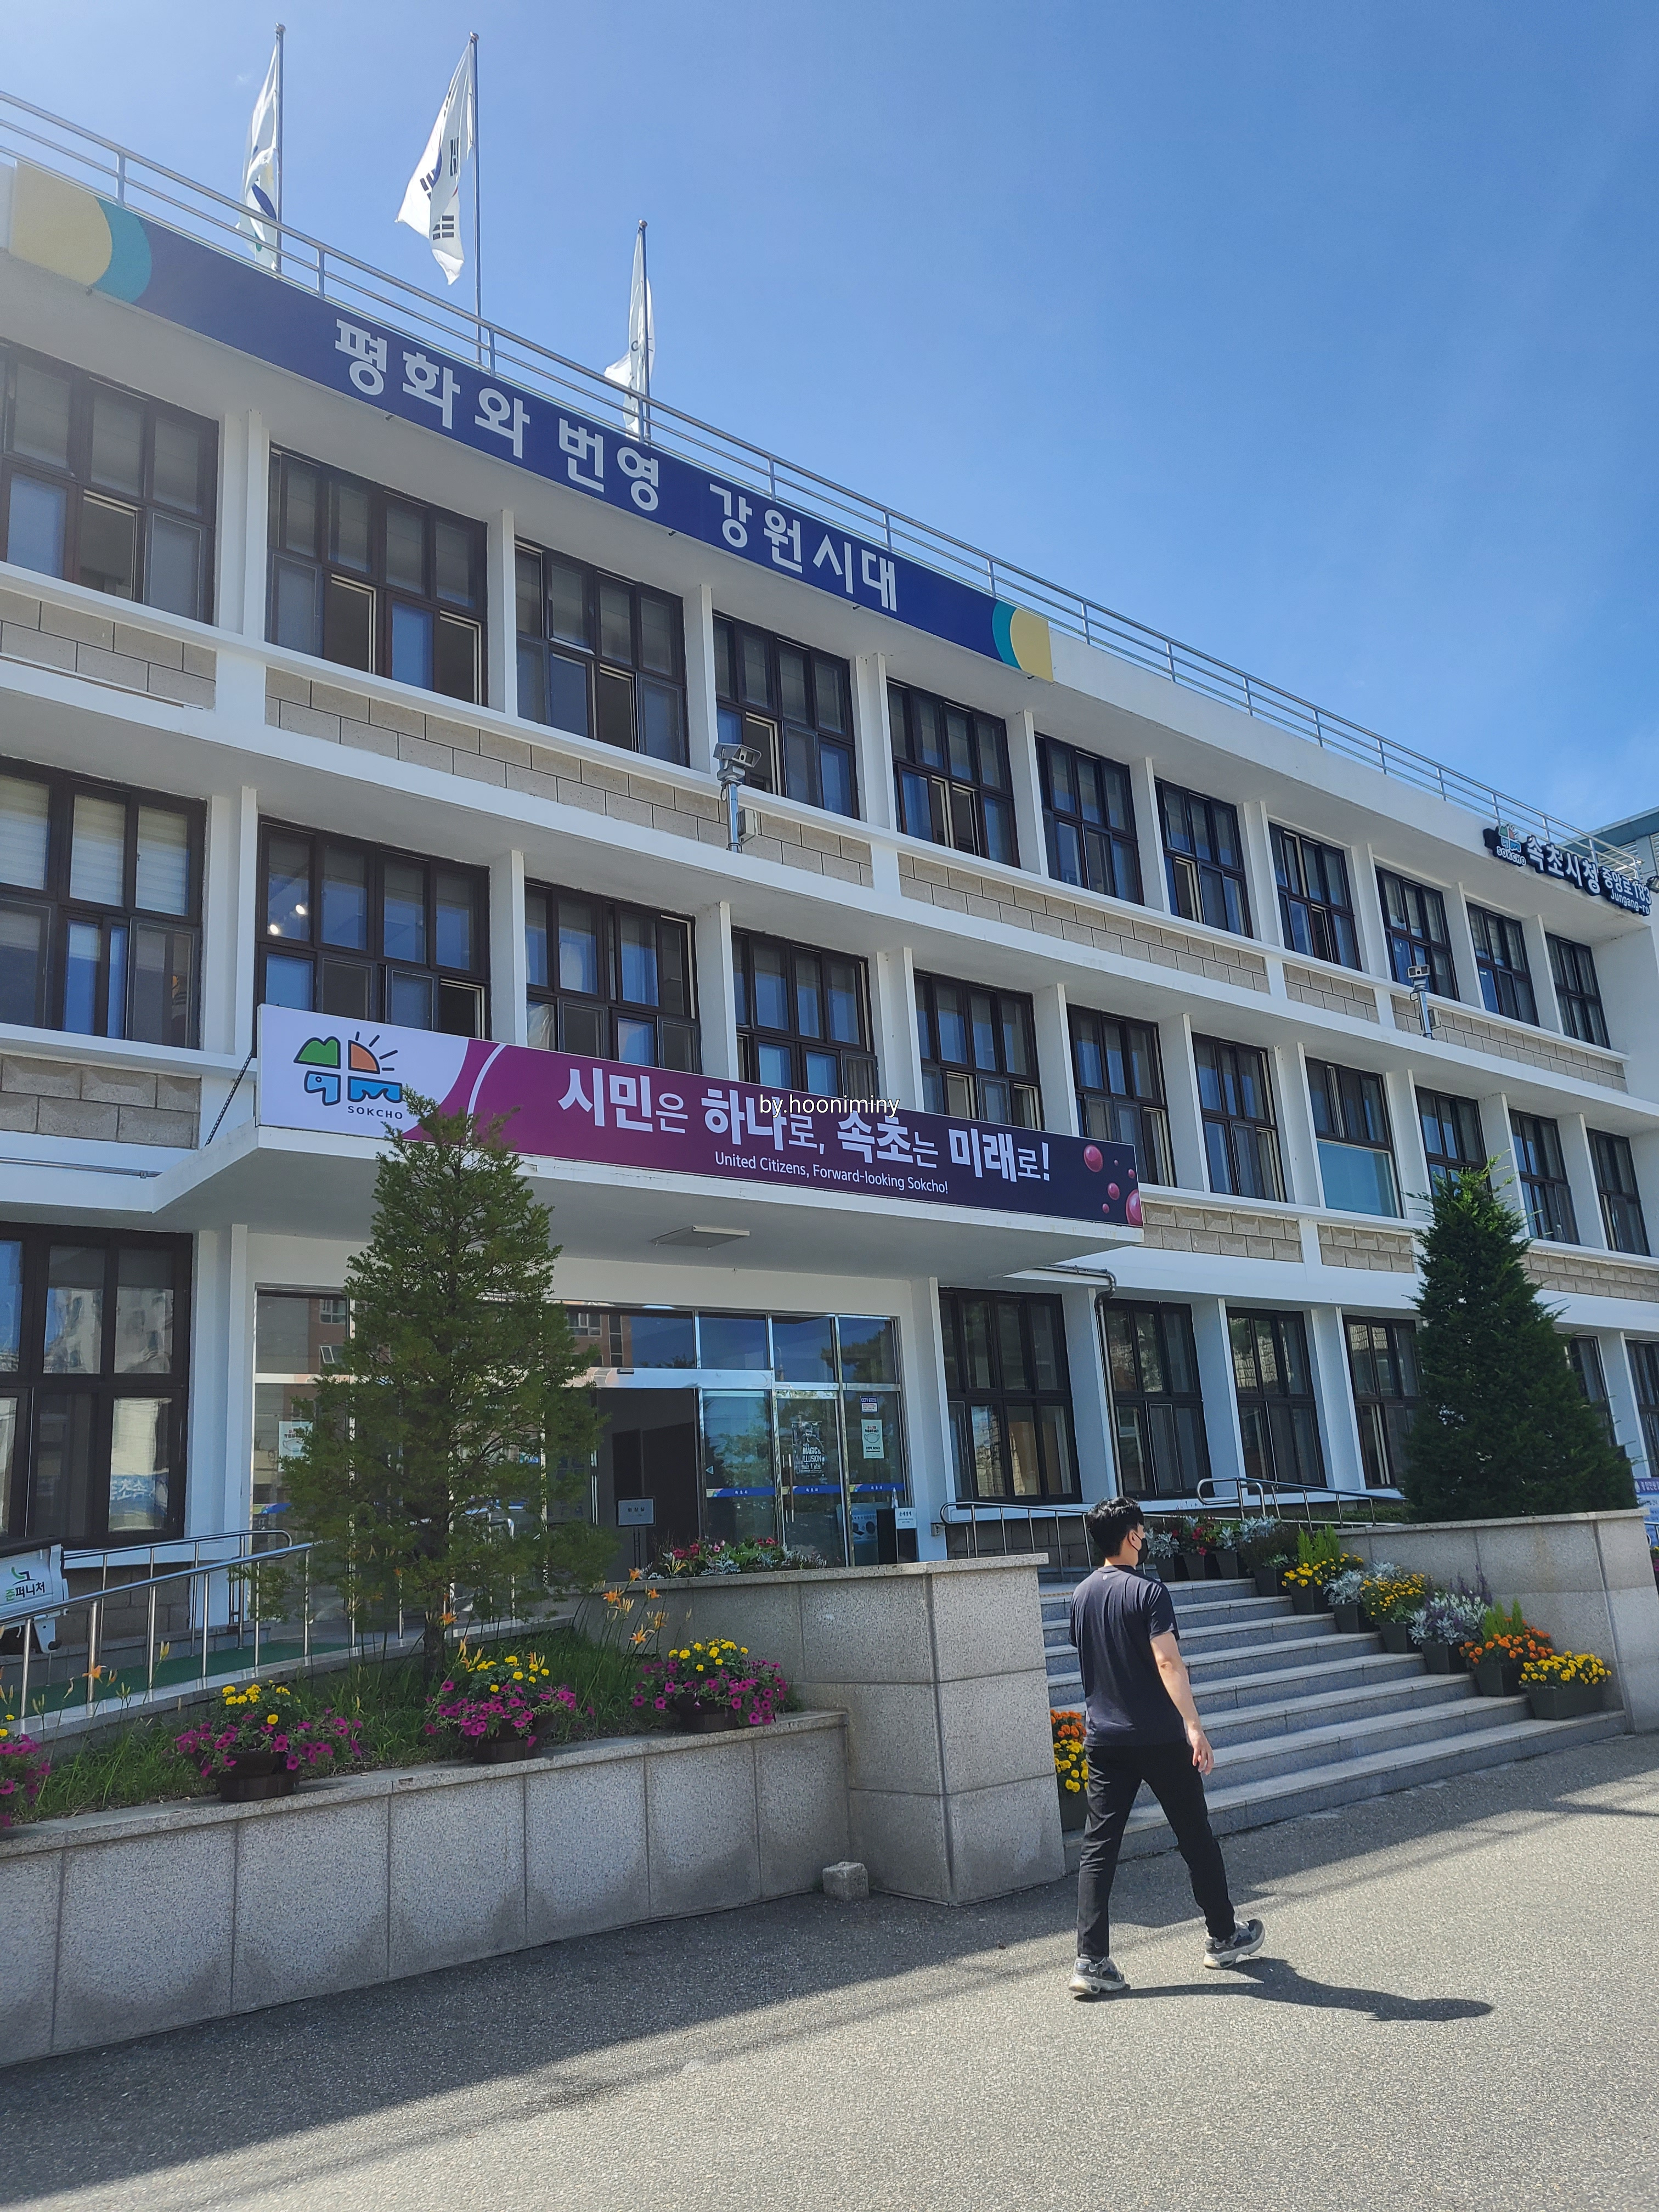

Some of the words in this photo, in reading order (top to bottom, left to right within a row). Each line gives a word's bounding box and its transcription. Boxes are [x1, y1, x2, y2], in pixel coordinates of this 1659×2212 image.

[335, 318, 531, 459] 평화와
[558, 417, 659, 511] 번영
[709, 483, 898, 612] 강원시대
[1497, 846, 1526, 866] SOKCHO
[1527, 836, 1600, 894] 속초시청
[1611, 889, 1650, 915] Jungang-ro
[347, 1105, 403, 1119] SOKCHO
[558, 1067, 688, 1133] 시민은
[701, 1088, 825, 1155] 하나로,
[837, 1110, 939, 1169] 속초는
[949, 1128, 1050, 1182] 미래로!
[715, 1151, 756, 1169] United
[760, 1157, 810, 1178] Citizens,
[812, 1164, 905, 1190] Forward-looking
[907, 1177, 949, 1194] Sokcho!
[802, 1454, 822, 1463] ILLUSION
